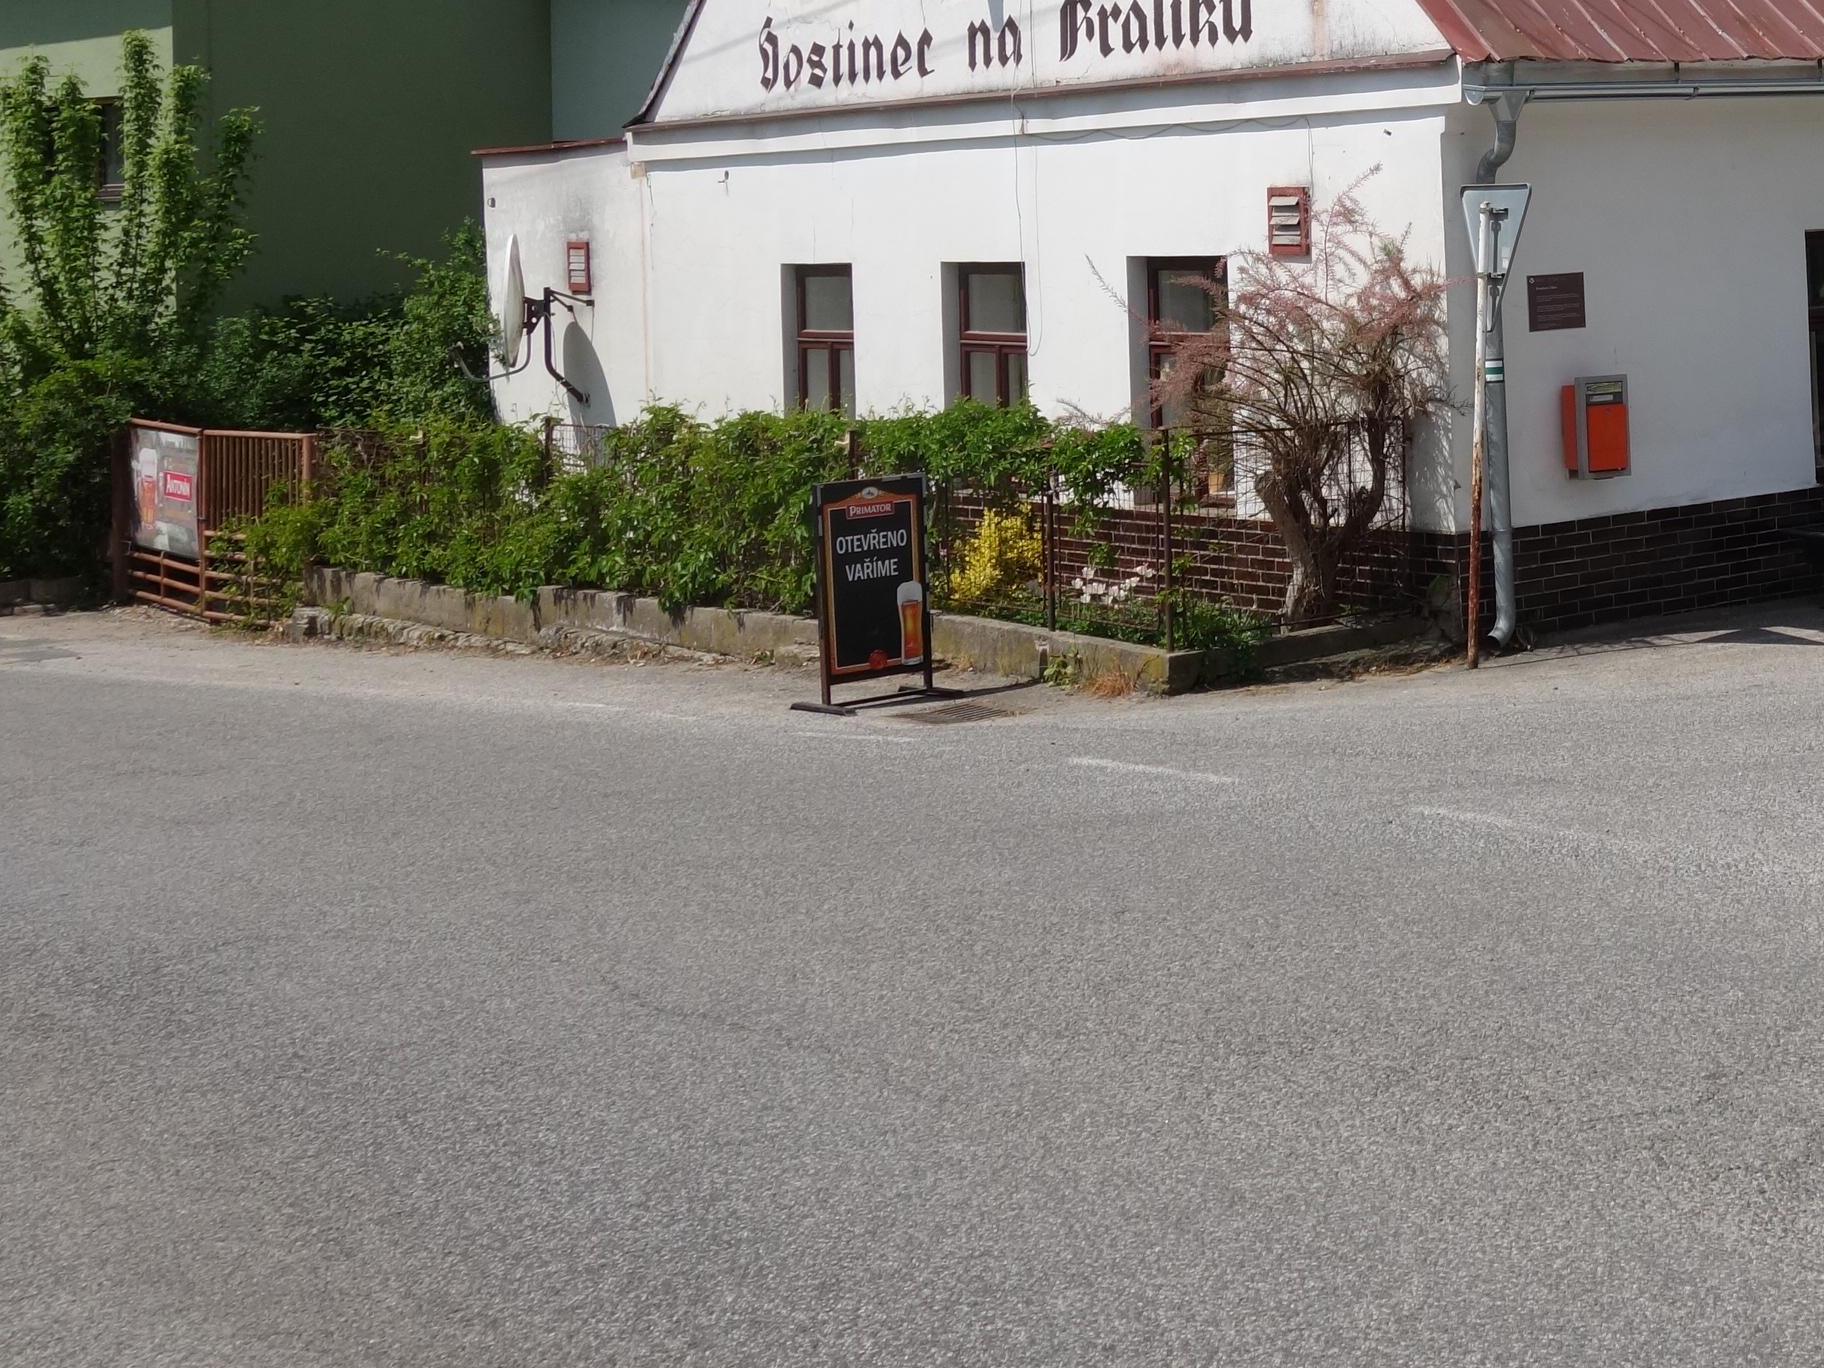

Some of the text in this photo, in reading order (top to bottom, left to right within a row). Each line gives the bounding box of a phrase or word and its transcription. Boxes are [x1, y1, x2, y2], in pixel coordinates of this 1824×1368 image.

[759, 16, 935, 93] Hostinec
[968, 14, 1022, 72] na
[849, 503, 892, 517] PRIMATOR
[836, 528, 907, 554] OTEVŘENO
[845, 556, 899, 582] VAŘÍME
